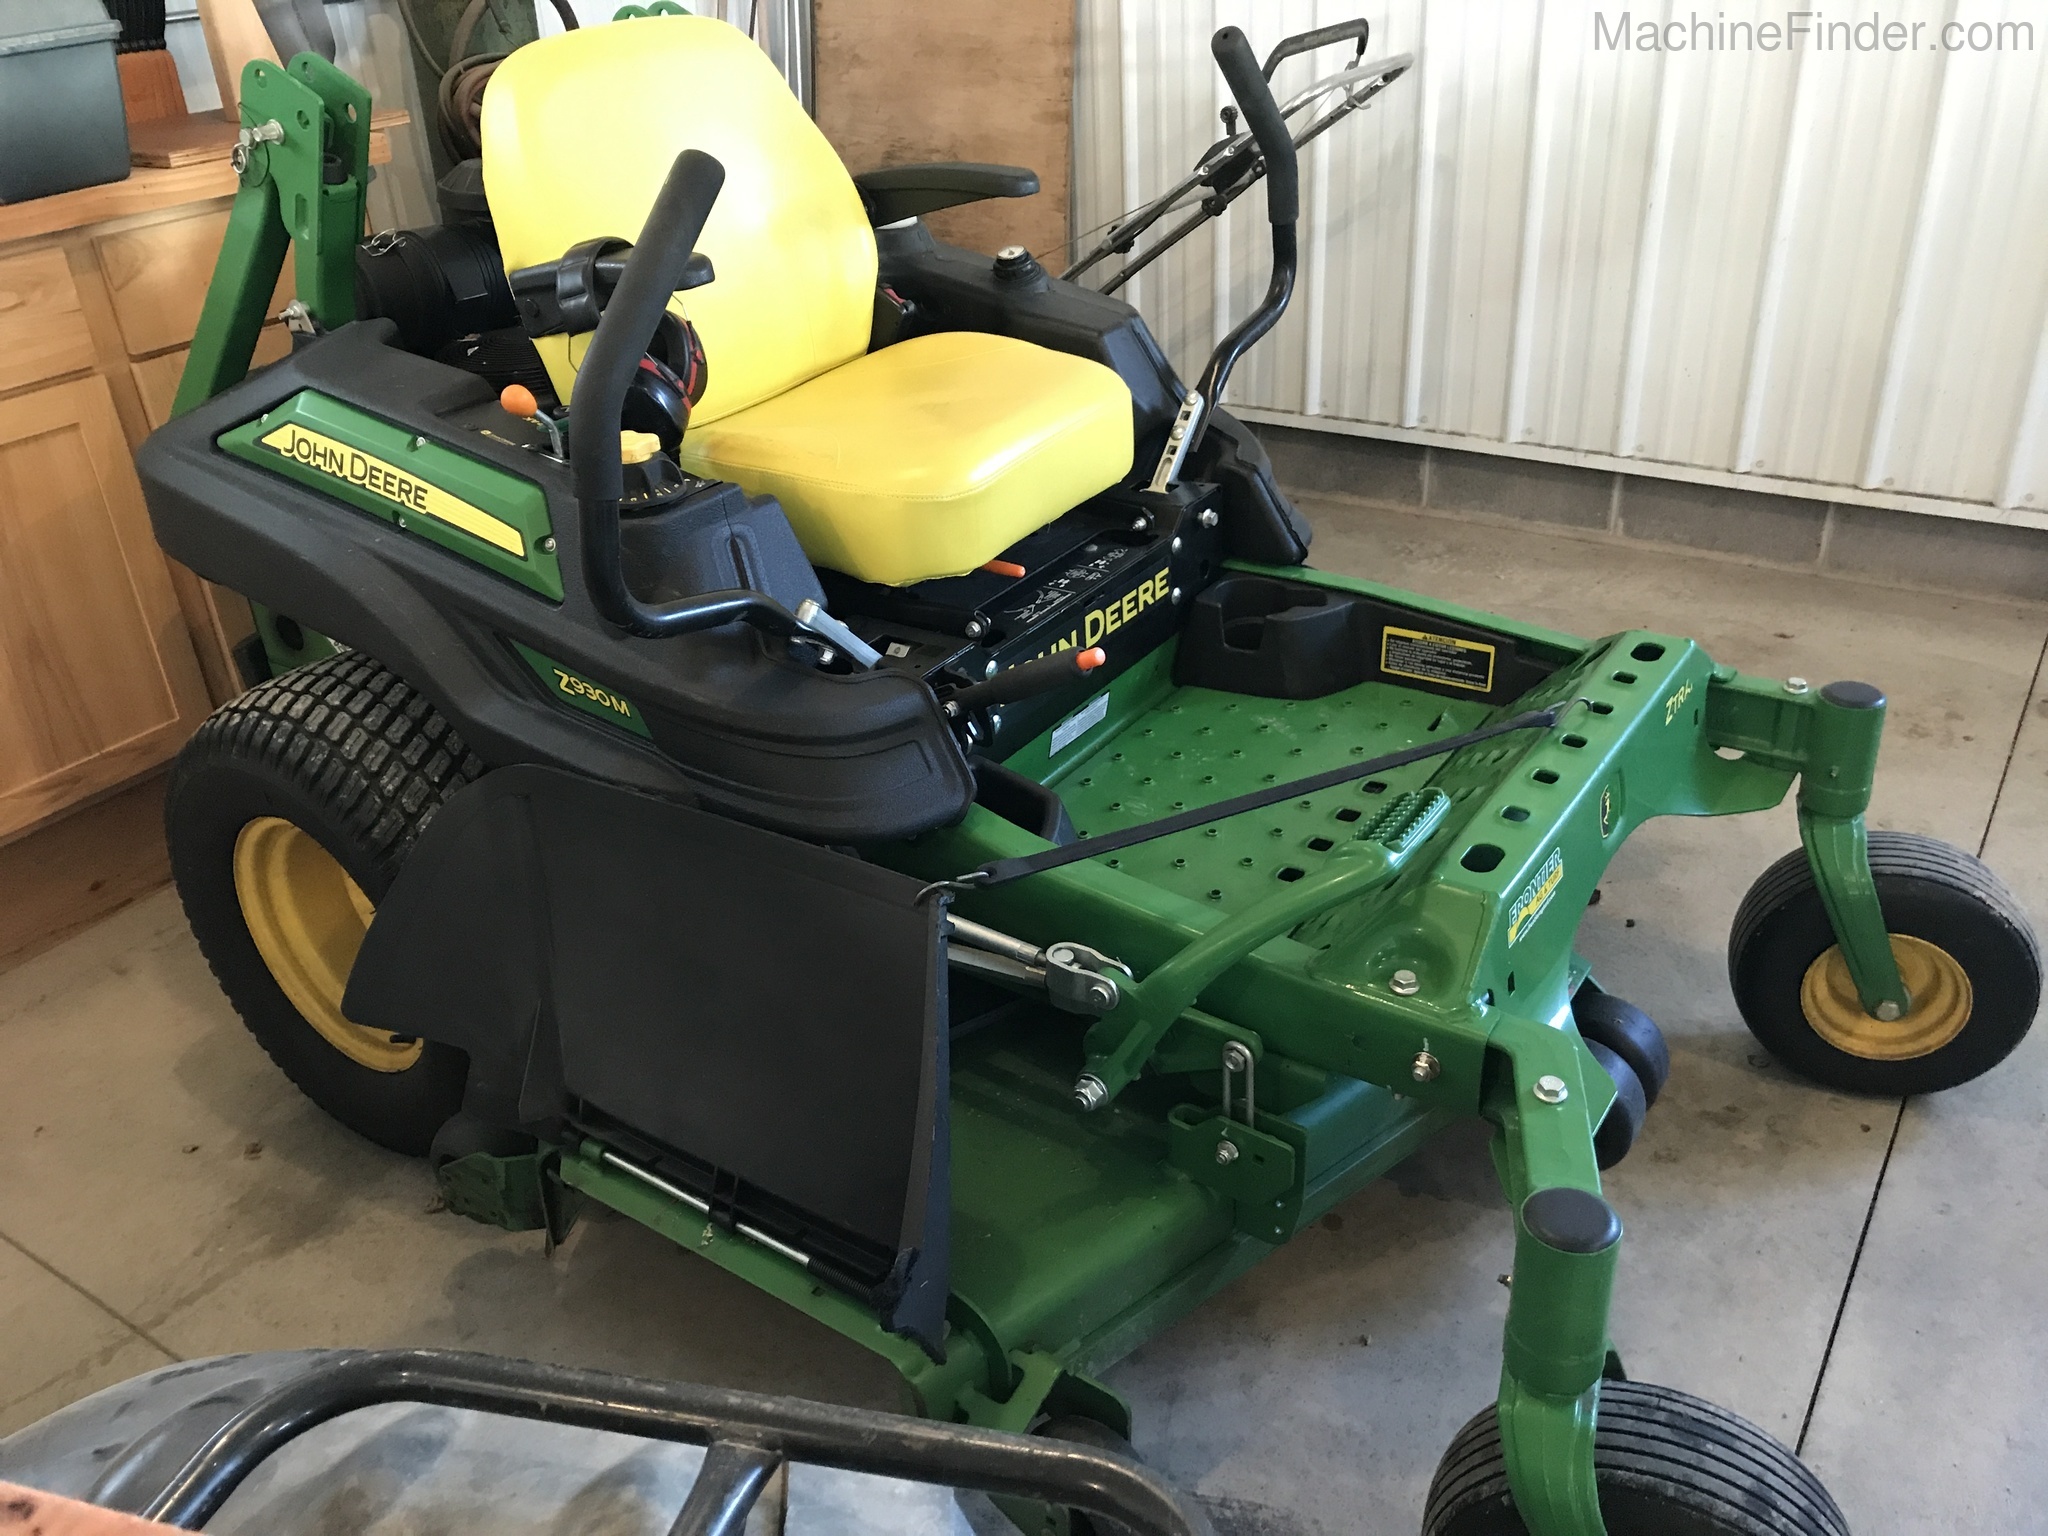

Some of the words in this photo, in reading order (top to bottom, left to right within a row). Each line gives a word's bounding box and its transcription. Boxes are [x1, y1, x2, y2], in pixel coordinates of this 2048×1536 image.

[283, 429, 344, 475] JOHN
[350, 451, 429, 510] DEERE
[1084, 567, 1170, 649] DEERE
[552, 668, 631, 718] Z930M
[1508, 847, 1562, 928] FRONTIER
